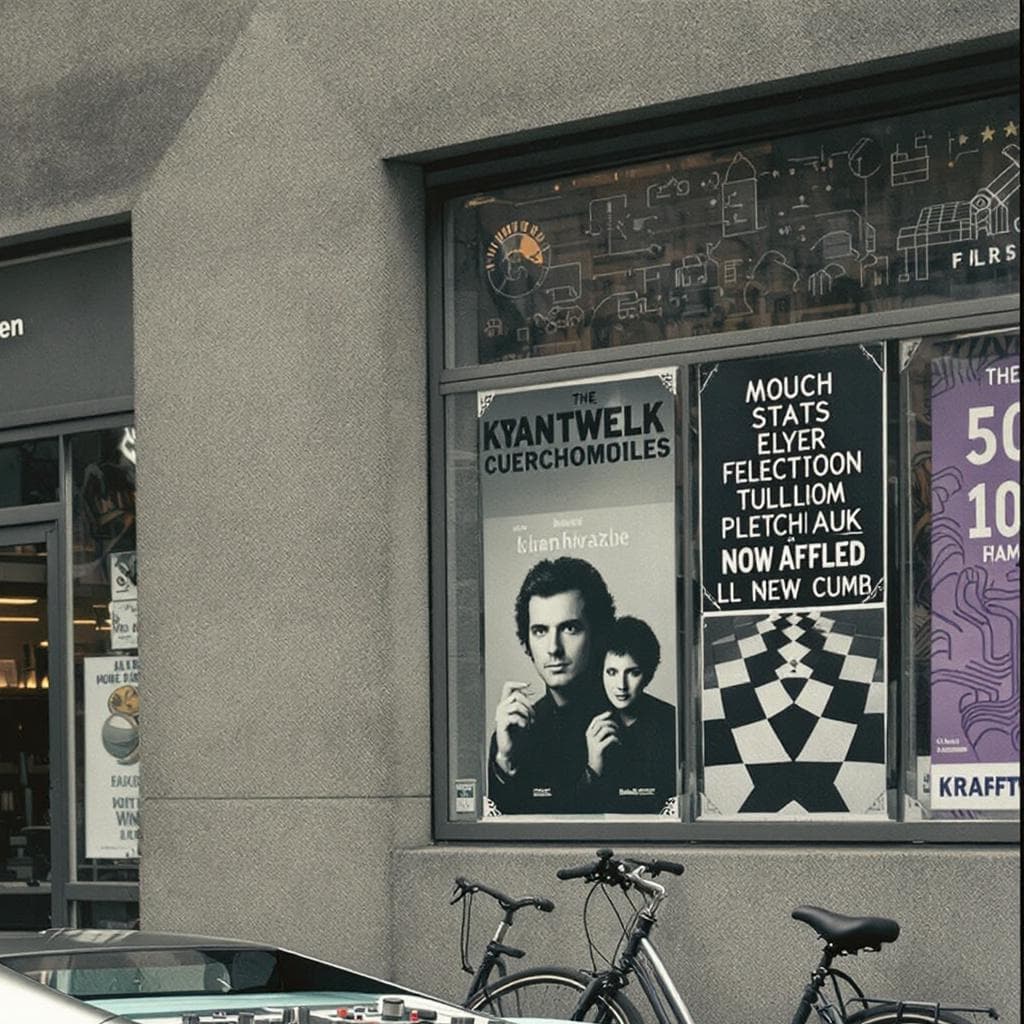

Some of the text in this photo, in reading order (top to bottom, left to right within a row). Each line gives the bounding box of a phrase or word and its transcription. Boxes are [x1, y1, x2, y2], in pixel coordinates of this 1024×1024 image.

[572, 391, 598, 406] THE
[745, 371, 834, 403] MOUCH
[751, 400, 831, 430] STATS
[757, 427, 827, 456] ELYER
[721, 545, 775, 576] NOW
[751, 577, 803, 603] NEW
[811, 573, 873, 599] CUMB
